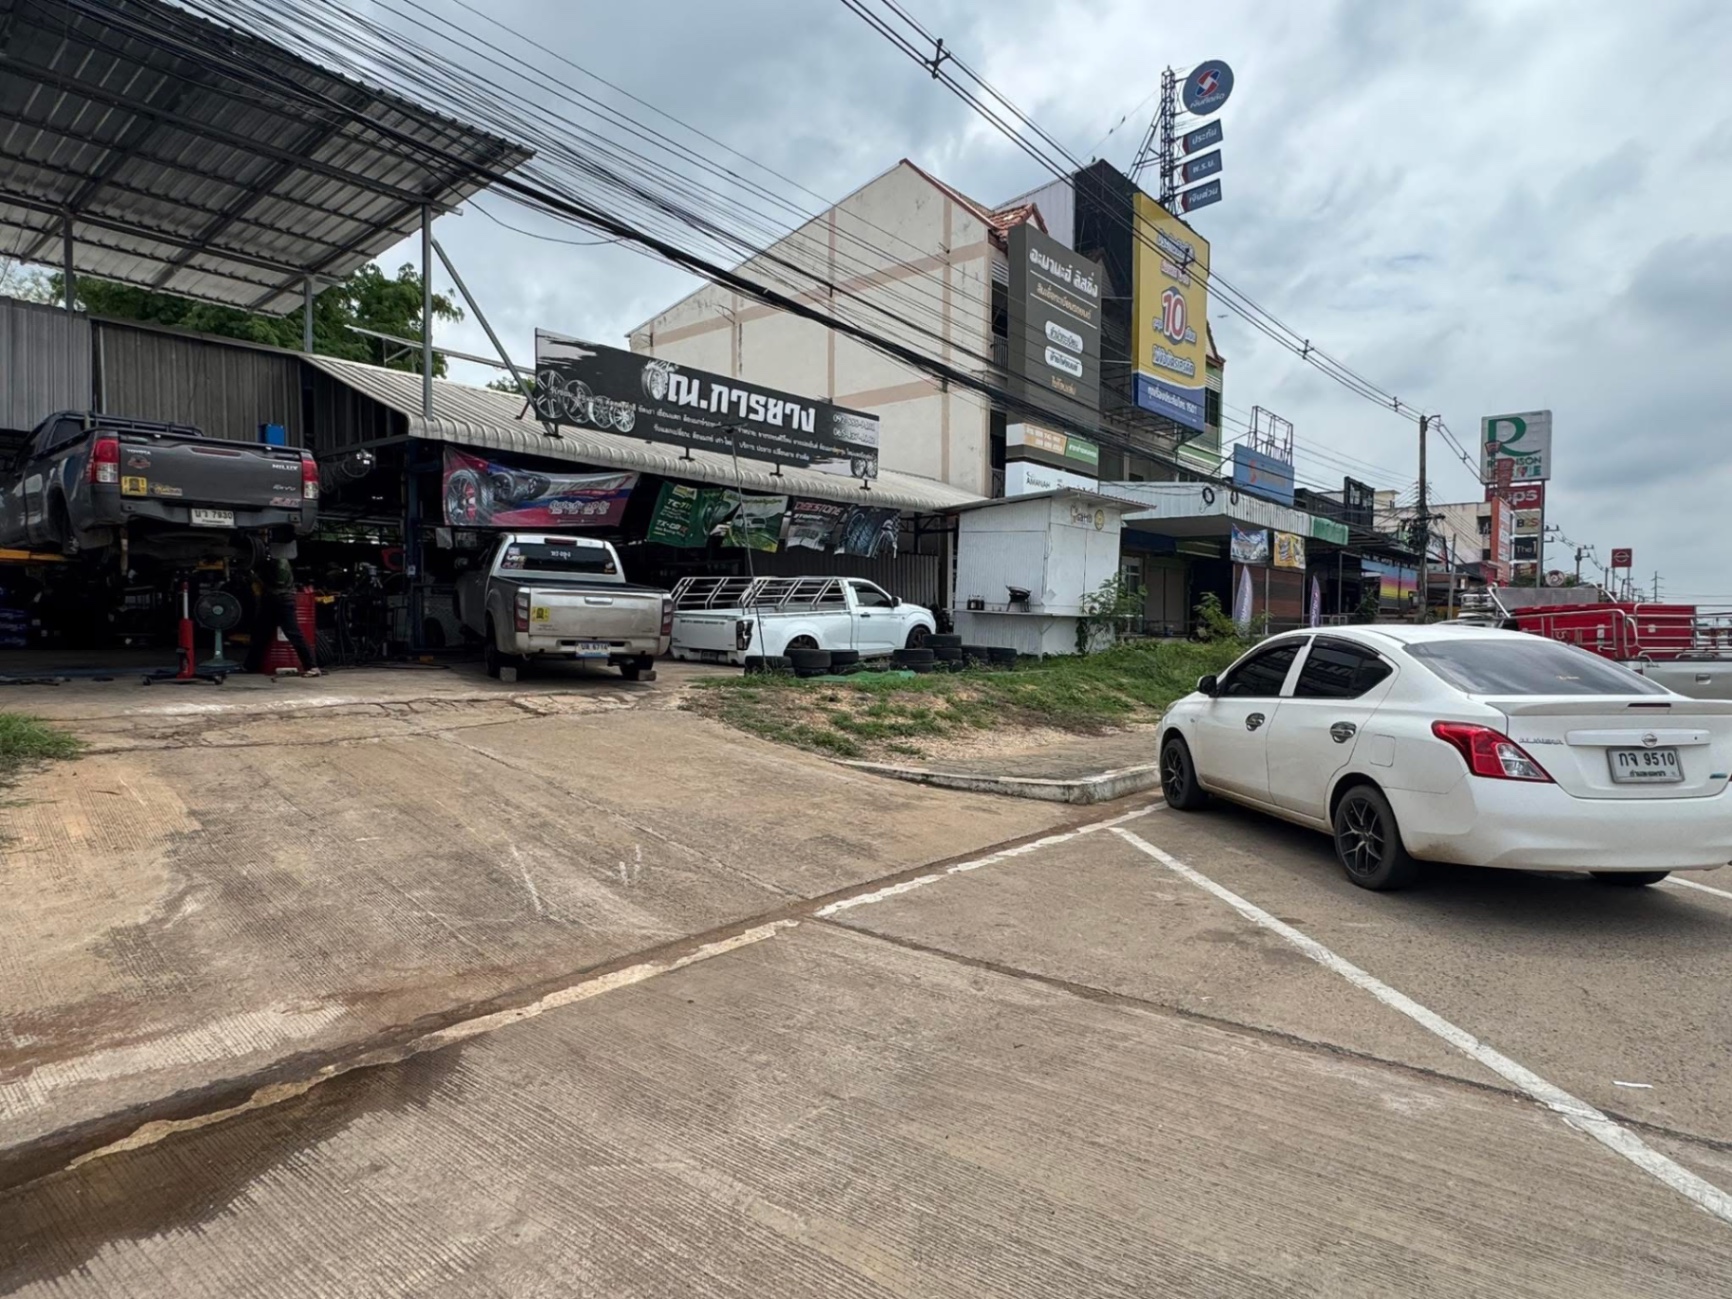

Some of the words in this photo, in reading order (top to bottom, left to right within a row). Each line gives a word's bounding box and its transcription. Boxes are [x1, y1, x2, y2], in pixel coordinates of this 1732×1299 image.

[1192, 127, 1217, 145] ประกัน
[1192, 161, 1215, 174] พ.ร.บ.
[1189, 187, 1218, 203] เงินด่วน
[1029, 248, 1073, 283] อะมานะฮ์
[1072, 270, 1099, 298] ลิสซิ่ง
[1162, 291, 1186, 340] 10
[667, 373, 816, 433] ณ.การยาง
[272, 463, 298, 471] HILUX
[1516, 545, 1532, 554] The
[1618, 752, 1638, 767] กจ
[1643, 752, 1675, 766] 9510
